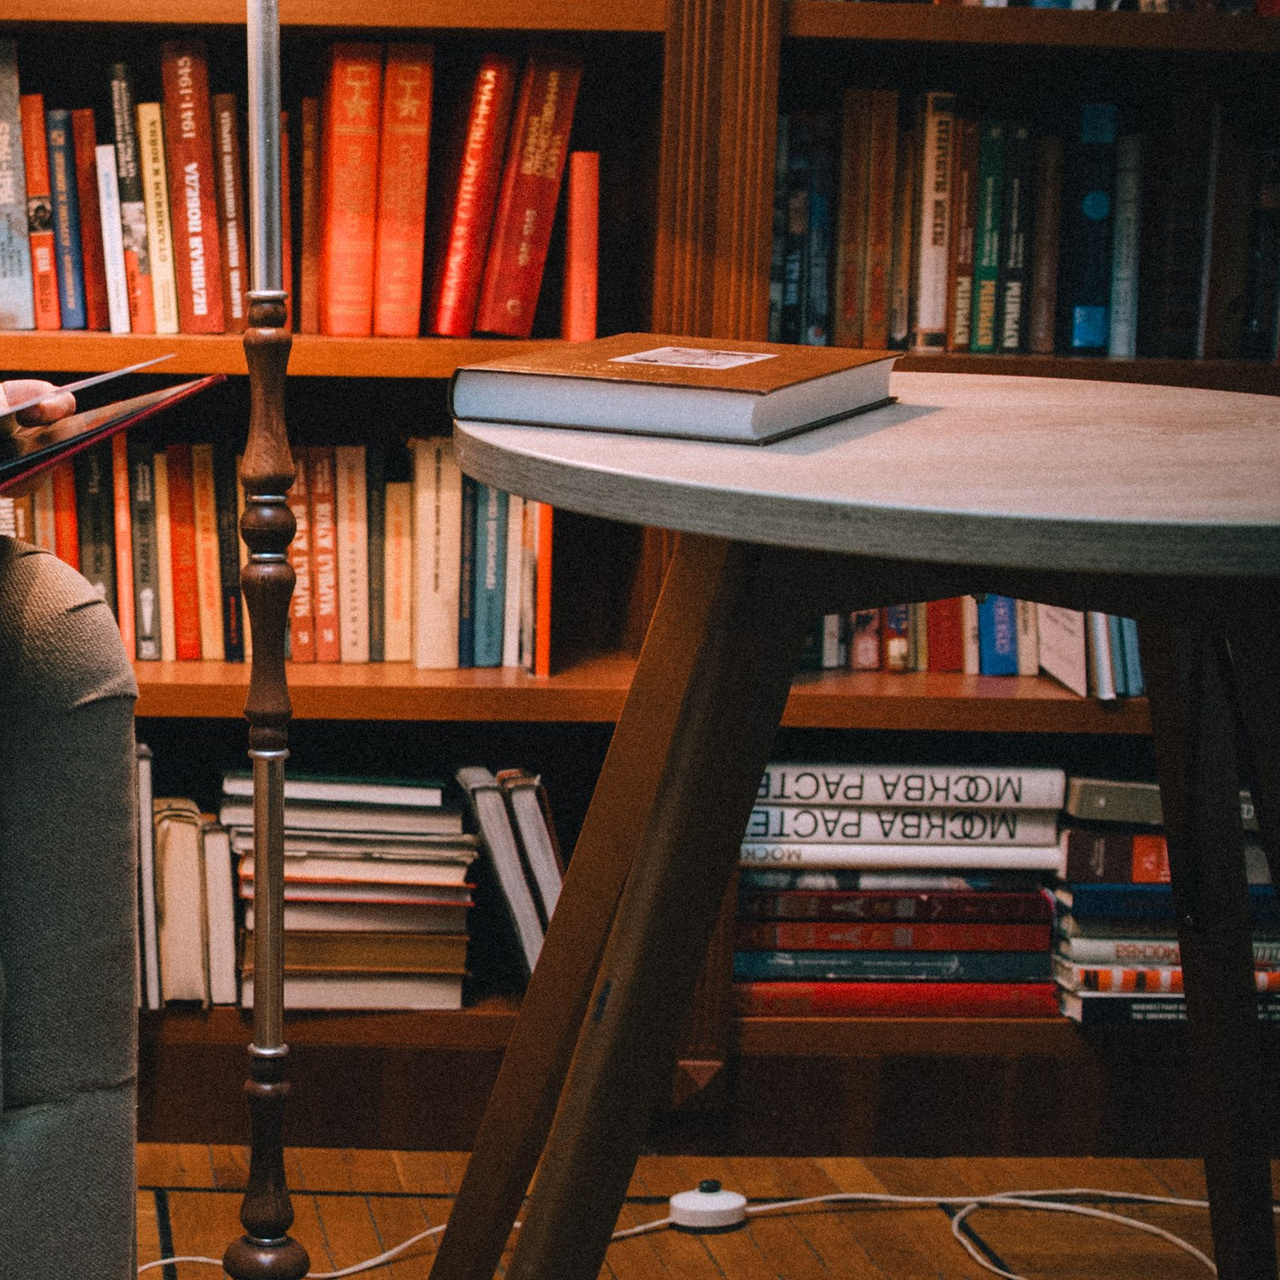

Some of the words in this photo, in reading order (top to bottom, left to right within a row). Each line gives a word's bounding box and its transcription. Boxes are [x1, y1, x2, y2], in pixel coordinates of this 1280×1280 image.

[176, 56, 197, 140] 1941-1945
[147, 119, 160, 164] ВОЙНА
[183, 161, 204, 233] ПОБЕДА
[187, 236, 208, 316] ВЕЛИКАЯ
[315, 502, 334, 550] ЖУКОВ
[289, 556, 310, 617] МАРШАЛ
[316, 554, 336, 616] МАРШАЛ
[759, 772, 866, 801] РАСТЕ
[879, 773, 1023, 804] МОСКВА
[751, 810, 862, 839] РАСТЕ
[881, 811, 1018, 841] МОСКВА
[740, 848, 802, 862] МОСК
